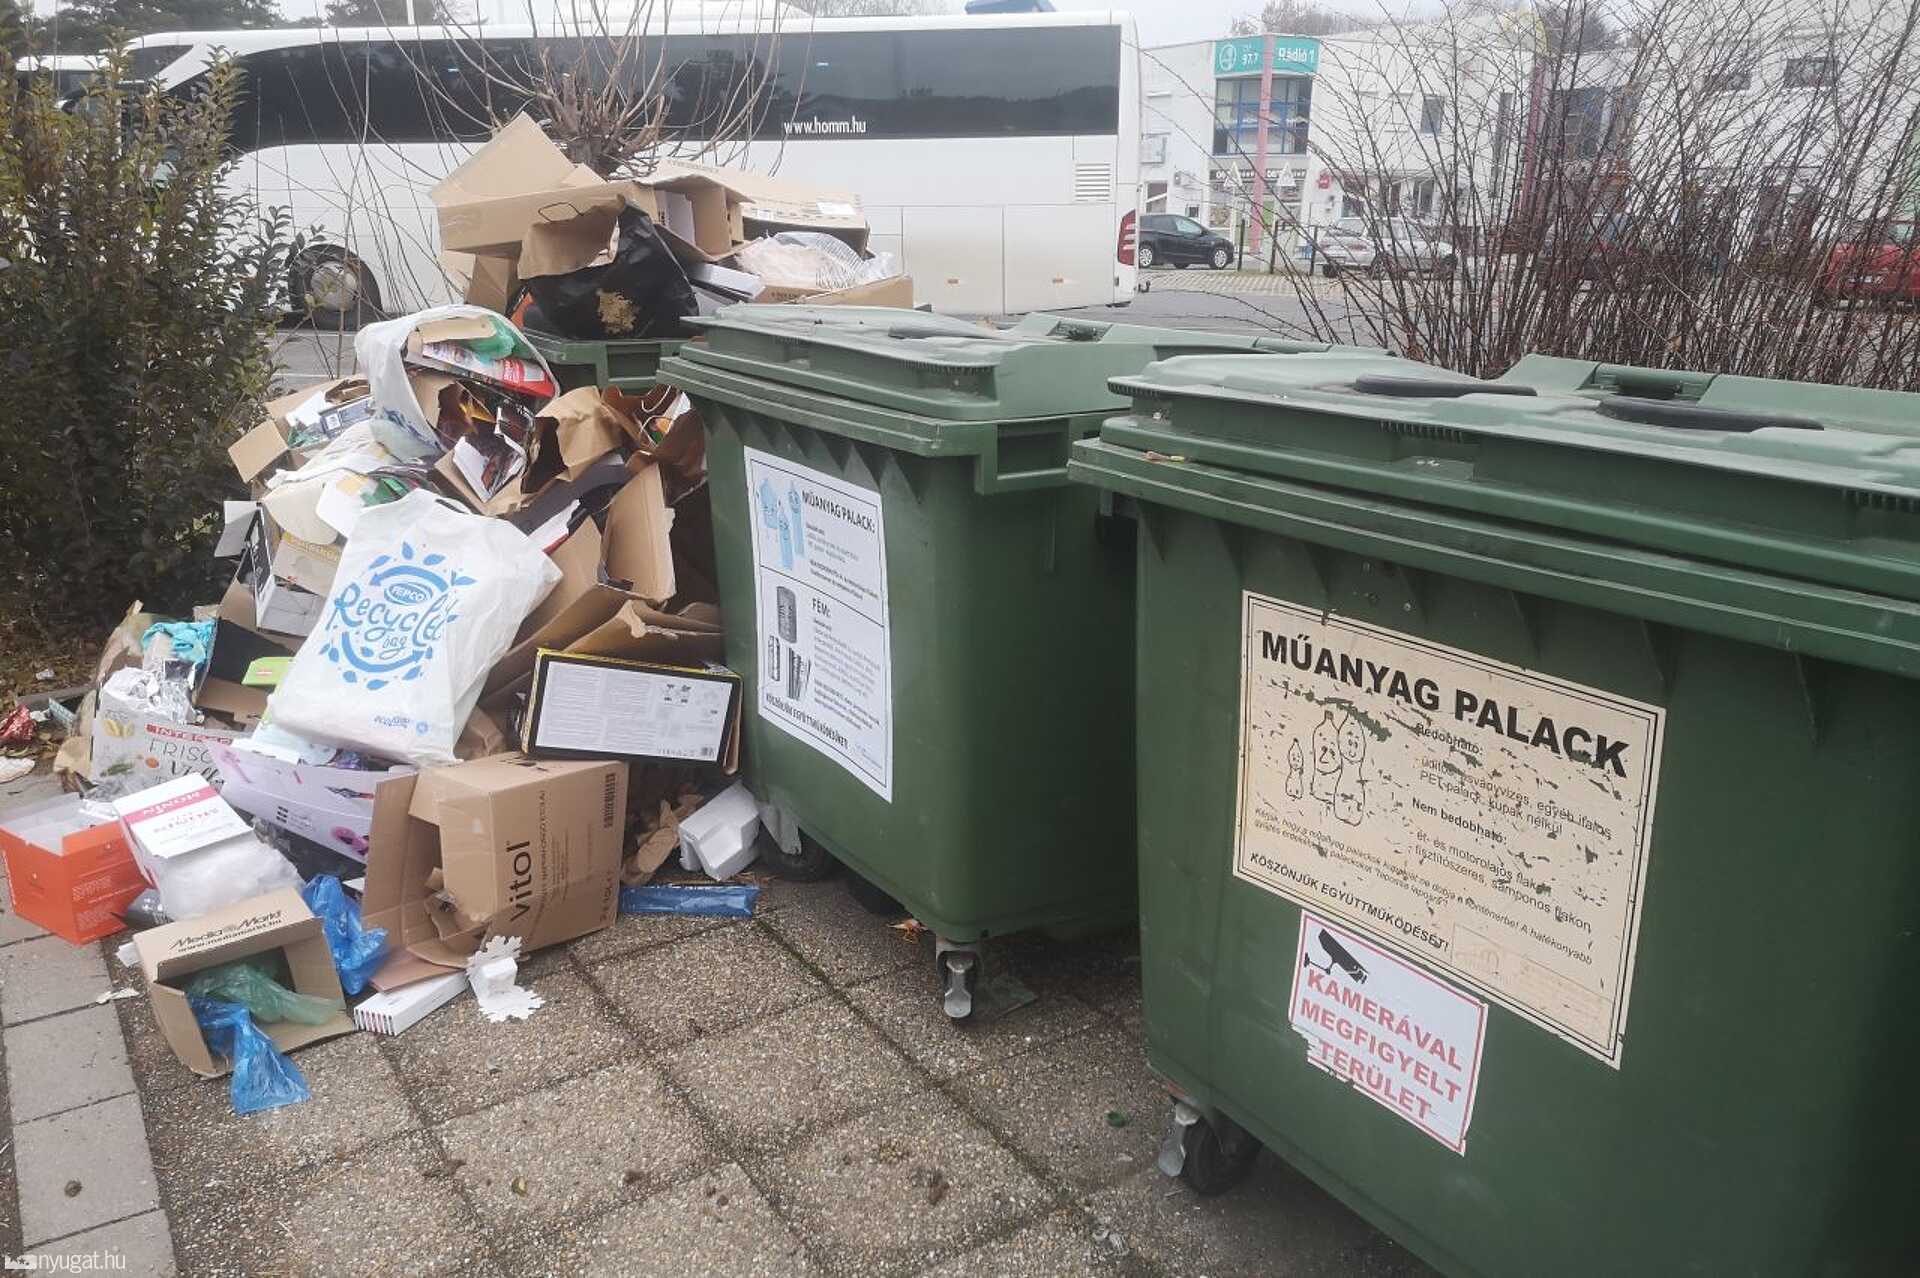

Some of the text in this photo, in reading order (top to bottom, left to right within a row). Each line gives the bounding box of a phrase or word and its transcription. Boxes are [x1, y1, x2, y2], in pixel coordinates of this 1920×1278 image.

[783, 115, 867, 134] www.homm.hu
[391, 586, 426, 601] PEPCO
[1262, 630, 1630, 778] MŰANYAG PALACK
[1412, 797, 1438, 817] Nem
[1516, 871, 1552, 895] flakn
[1306, 969, 1463, 1072] KAMERÁVAL
[1301, 998, 1462, 1104] MEGFIGYELT
[1318, 1040, 1432, 1119] TERÜLET
